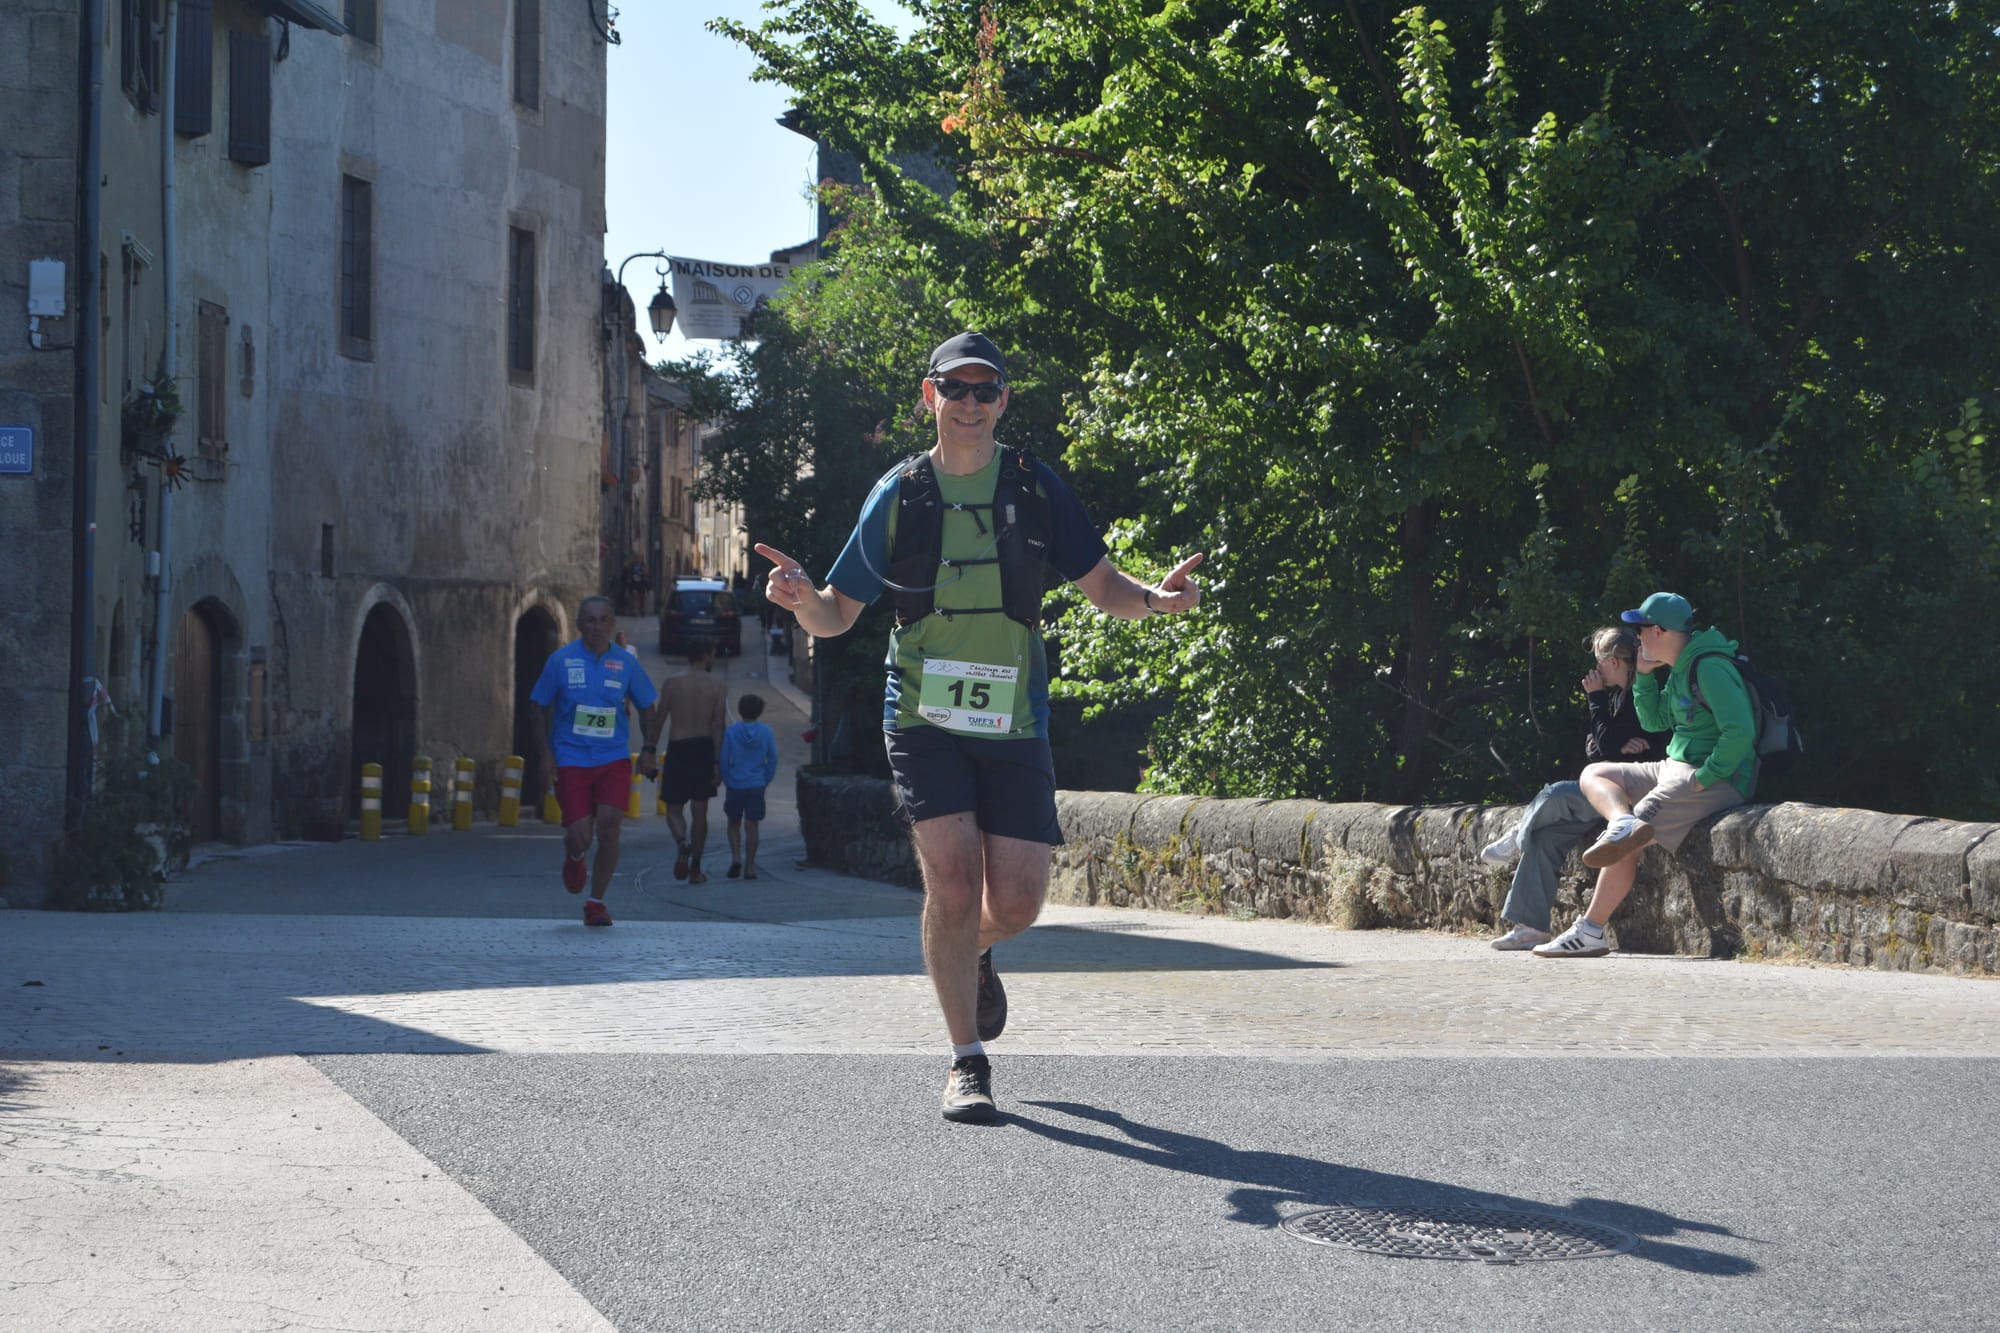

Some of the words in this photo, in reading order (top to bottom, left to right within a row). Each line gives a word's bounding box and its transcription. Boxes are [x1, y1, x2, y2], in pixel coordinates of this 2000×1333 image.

[676, 261, 753, 278] MAISON
[759, 267, 783, 278] DE
[948, 680, 990, 709] 15
[586, 714, 606, 727] 78
